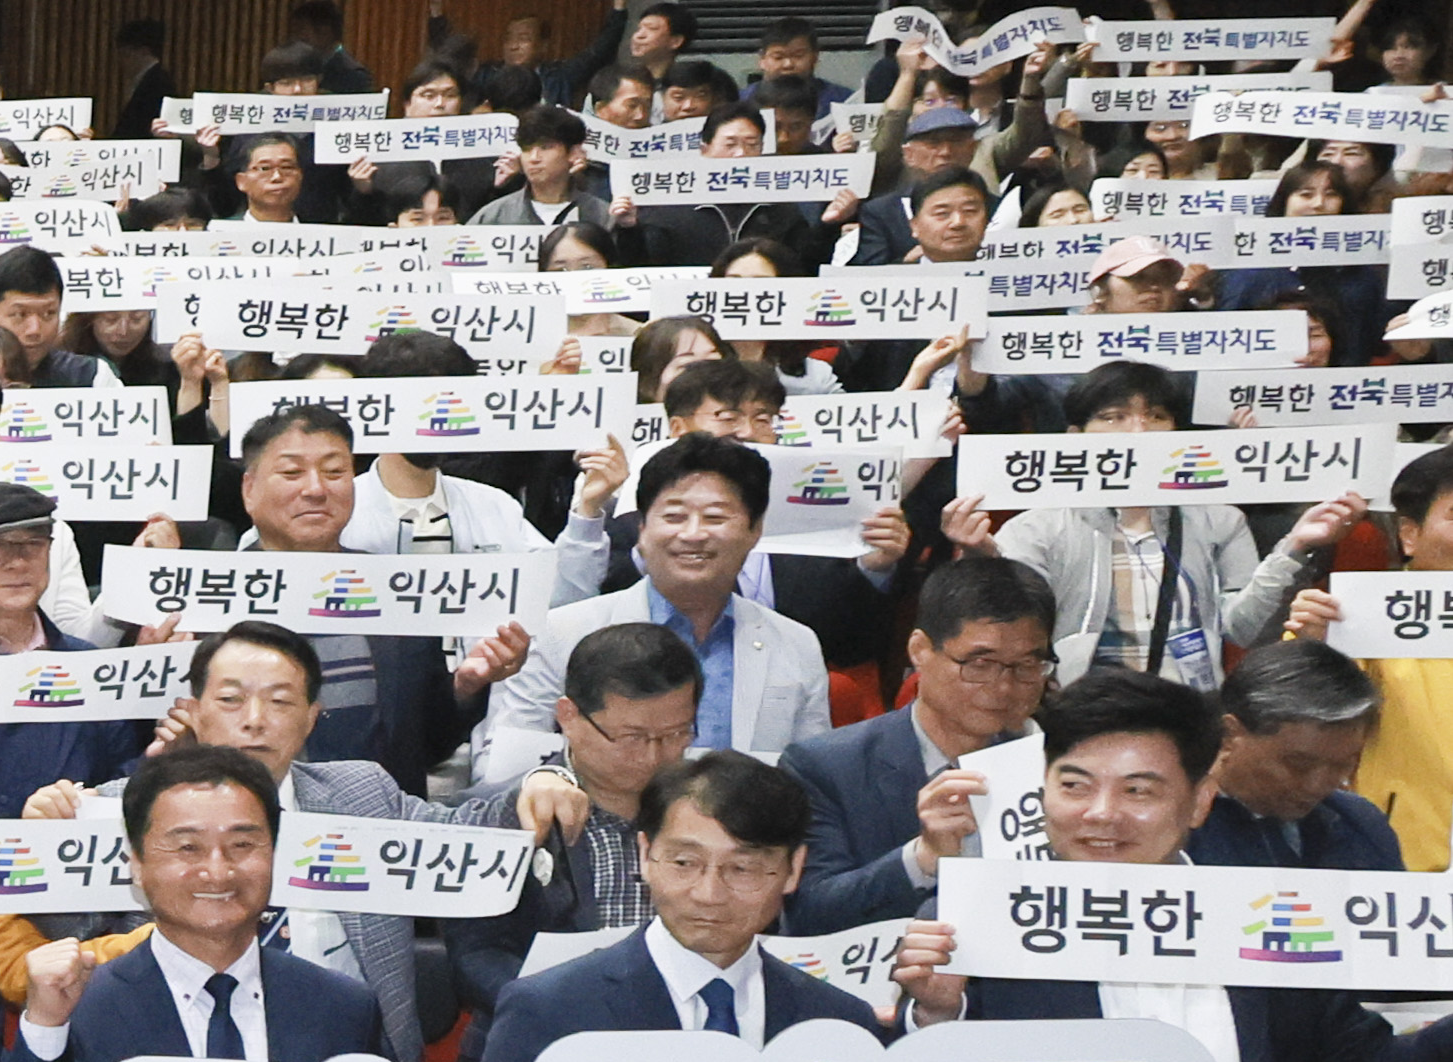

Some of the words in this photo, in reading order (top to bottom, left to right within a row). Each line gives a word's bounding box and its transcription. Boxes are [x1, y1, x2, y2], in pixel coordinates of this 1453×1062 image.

[1117, 31, 1173, 52] 행복한
[1183, 28, 1308, 50] 전북특별자치도
[212, 105, 264, 124] 행복한
[273, 104, 384, 123] 전북특별자치도
[1092, 89, 1157, 112] 행복한
[1214, 101, 1281, 123] 행복한
[1293, 102, 1449, 132] 전북특별자치도
[335, 132, 391, 153] 행복한
[402, 125, 518, 148] 전북특별자치도
[82, 162, 142, 193] 익산시
[632, 172, 695, 194] 행복한
[707, 167, 848, 191] 전북특별자치도
[1103, 192, 1167, 215] 행복한
[35, 209, 111, 237] 익산시
[239, 300, 348, 340] 행복한
[431, 305, 536, 344] 익산시
[686, 291, 786, 325] 행복한
[860, 288, 957, 322] 익산시
[1002, 331, 1082, 360] 행복한
[1097, 325, 1275, 357] 전북특별자치도
[485, 387, 602, 430] 익산시
[1230, 384, 1314, 415] 행복한
[55, 399, 157, 437] 익산시
[815, 403, 918, 443] 익산시
[63, 459, 179, 500] 익산시
[1006, 449, 1136, 492] 행복한
[1235, 438, 1361, 482] 익산시
[150, 567, 286, 614] 행복한
[389, 568, 518, 614] 익산시
[380, 839, 528, 897] 익산시
[1010, 886, 1202, 957] 행복한
